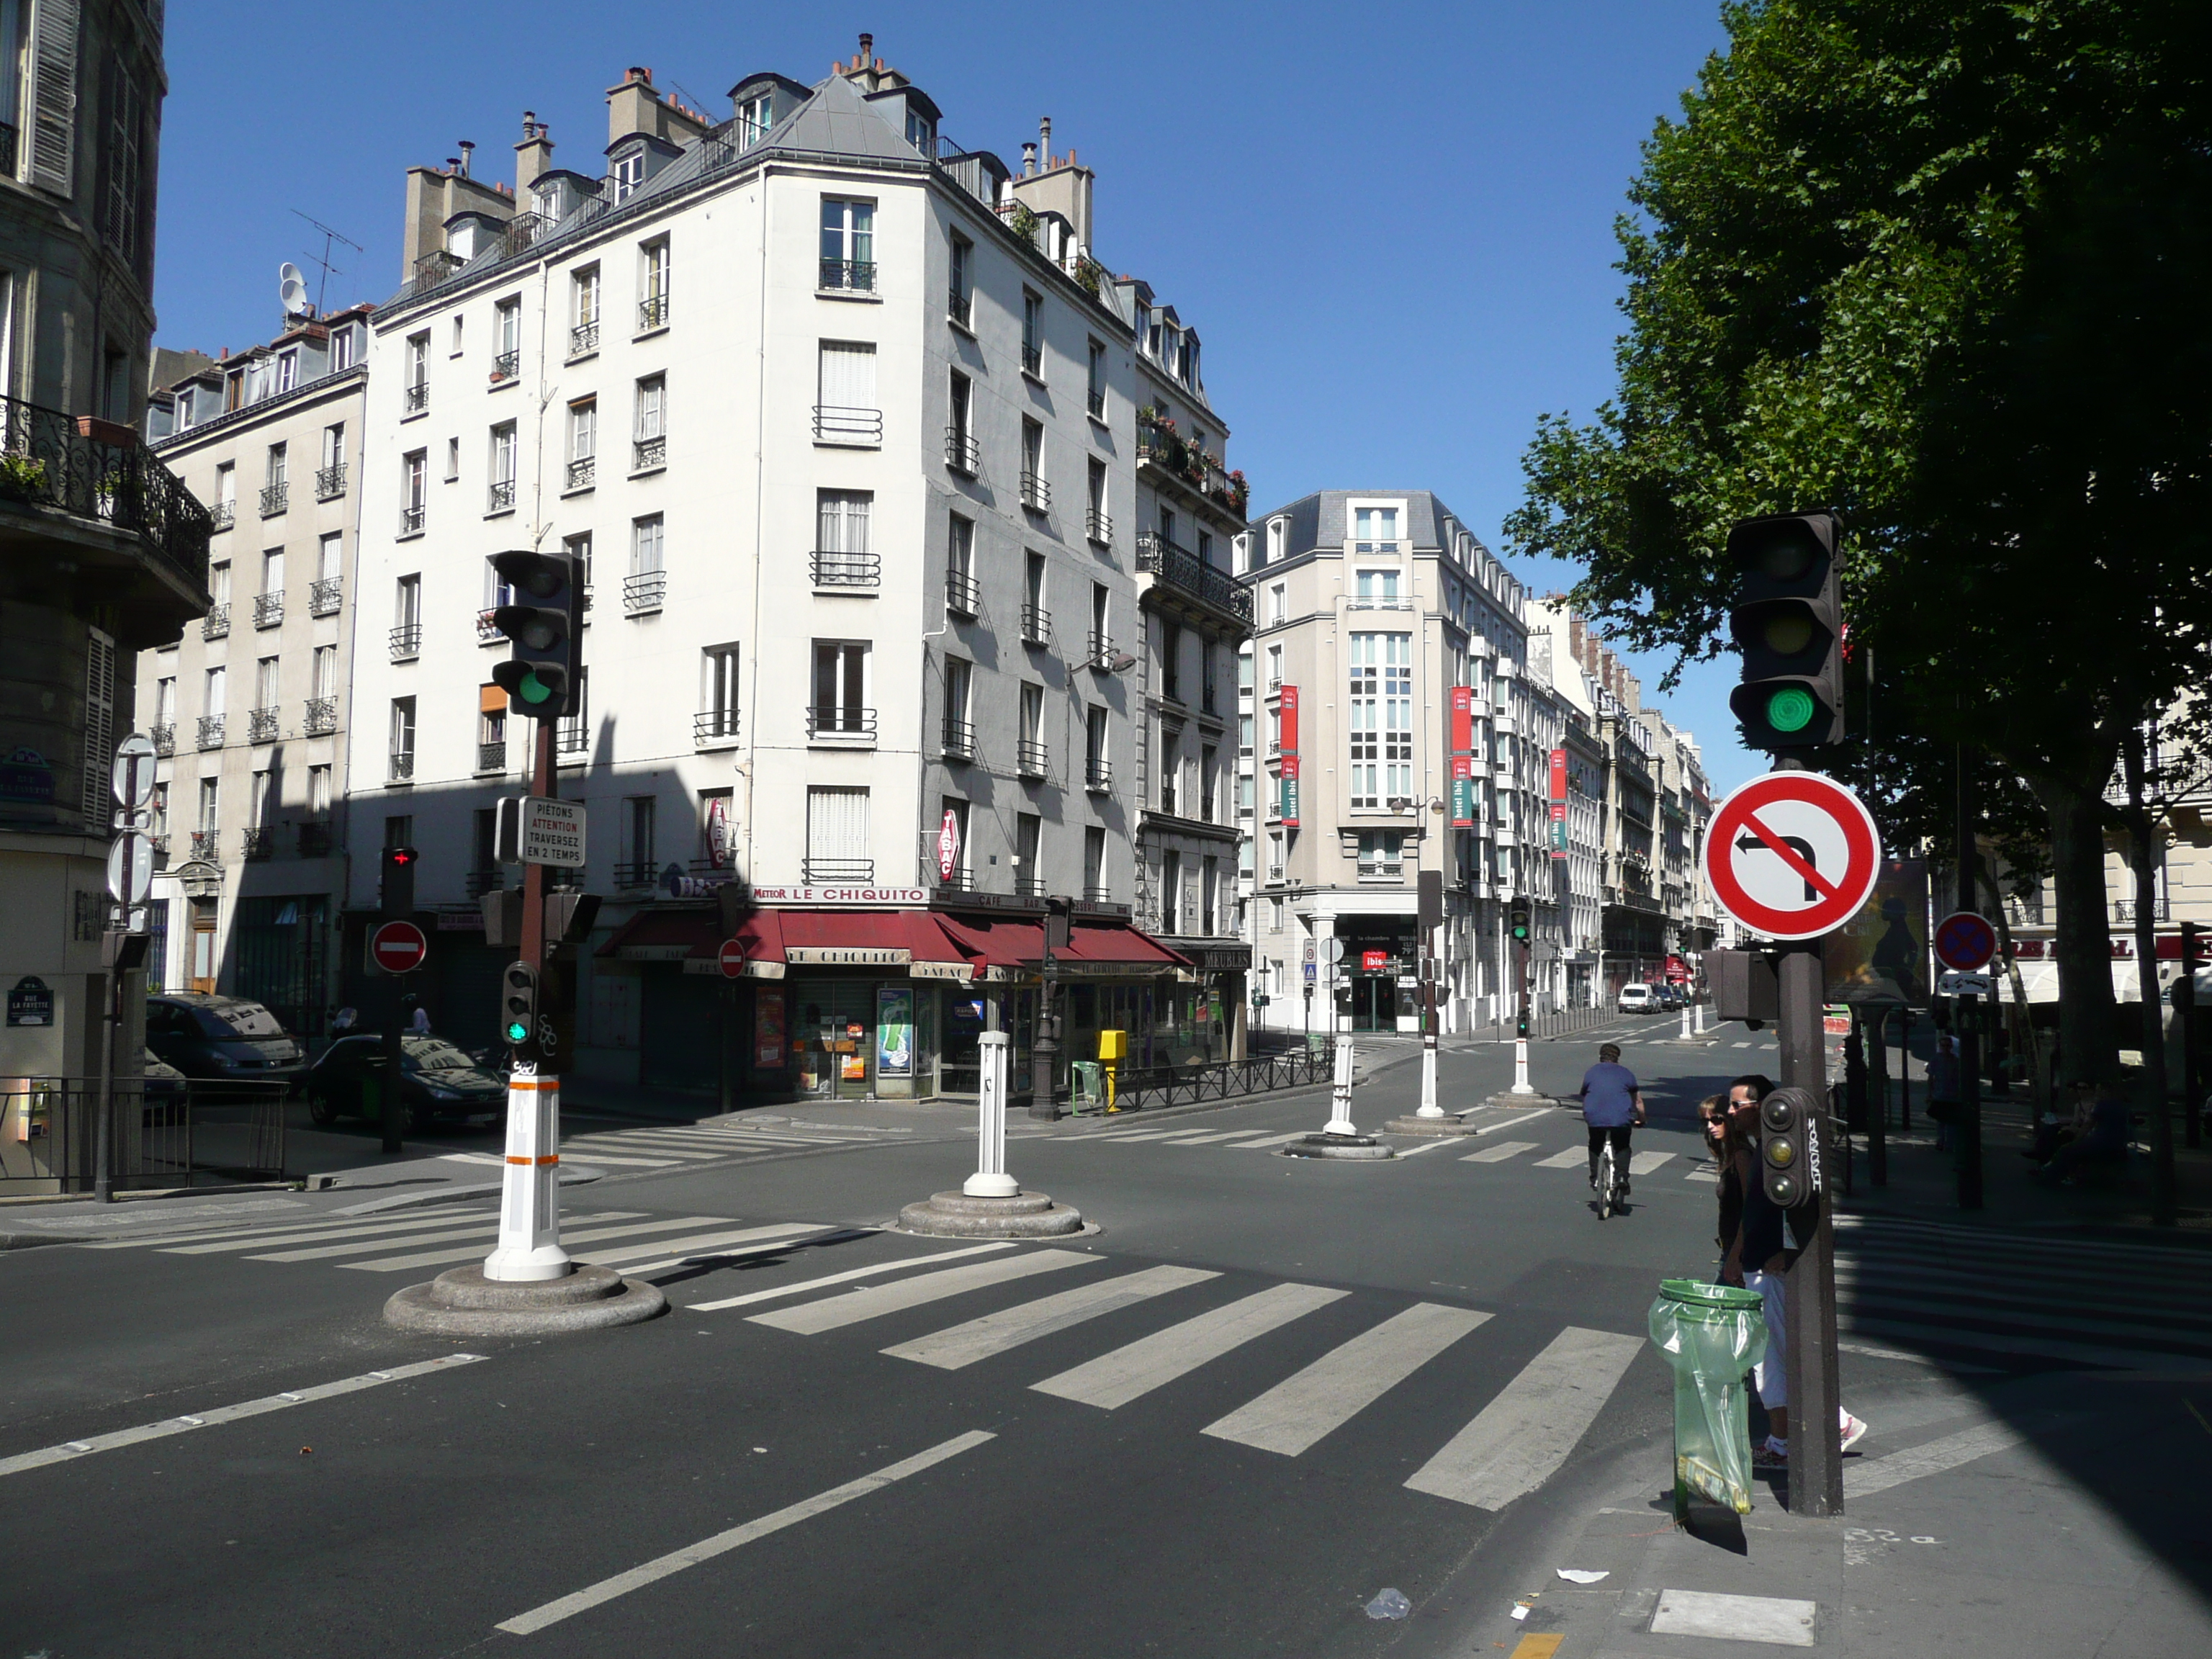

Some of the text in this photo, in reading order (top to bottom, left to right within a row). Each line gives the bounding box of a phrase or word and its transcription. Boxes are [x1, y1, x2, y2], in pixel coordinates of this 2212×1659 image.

[537, 804, 572, 818] PIÉTONS
[532, 818, 577, 832] ATTENTION
[530, 832, 578, 847] TRAVERSEZ
[715, 804, 724, 863] TABAC
[942, 816, 951, 874] TABAC
[528, 847, 580, 861] EN 2 TEMPS
[753, 889, 923, 900] METEOR LE CHIQUITO
[979, 895, 1000, 907] CAFE
[1024, 899, 1039, 908] BAR
[790, 951, 900, 963] LE CHIQUITO
[1205, 951, 1249, 968] MEUBLES
[1367, 957, 1382, 966] ibis
